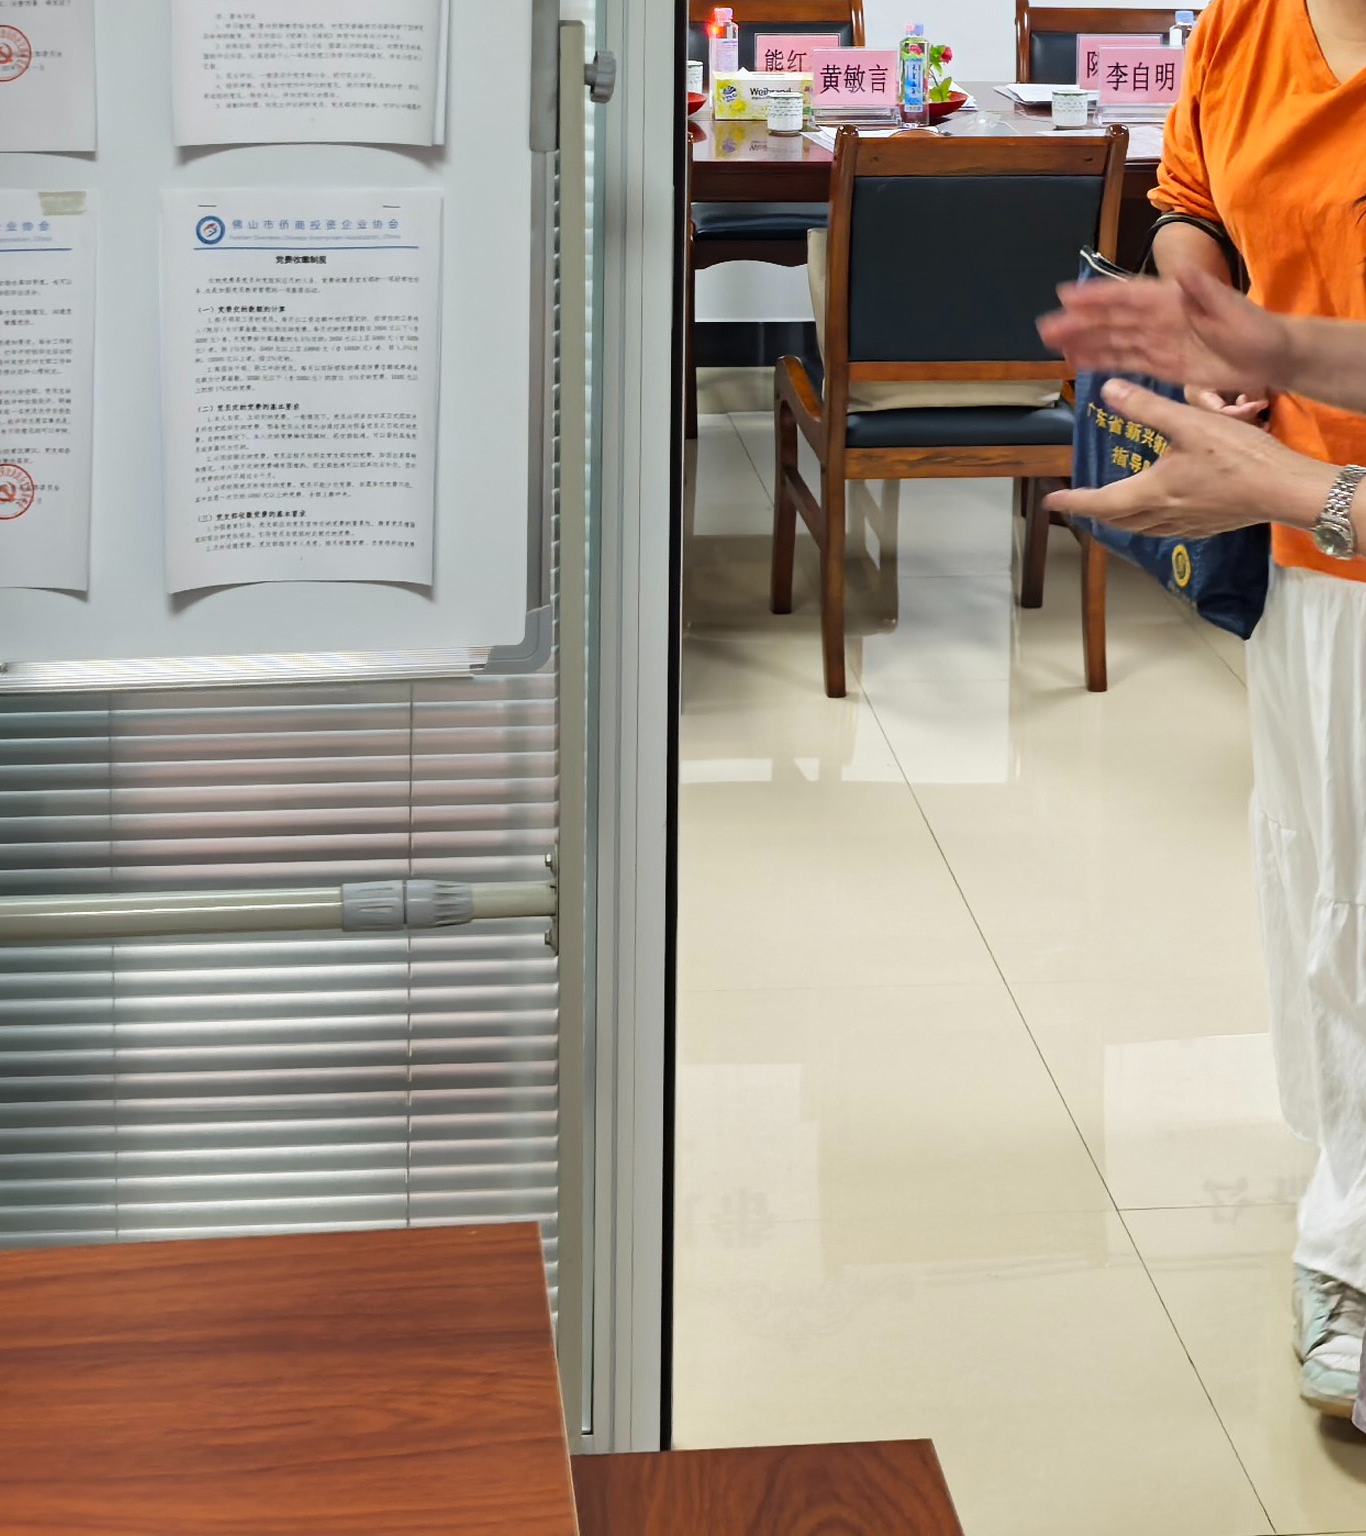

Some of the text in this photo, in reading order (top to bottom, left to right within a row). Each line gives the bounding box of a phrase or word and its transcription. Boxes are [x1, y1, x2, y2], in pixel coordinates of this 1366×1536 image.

[820, 63, 889, 94] 黄敏言
[1106, 61, 1175, 92] 李自明
